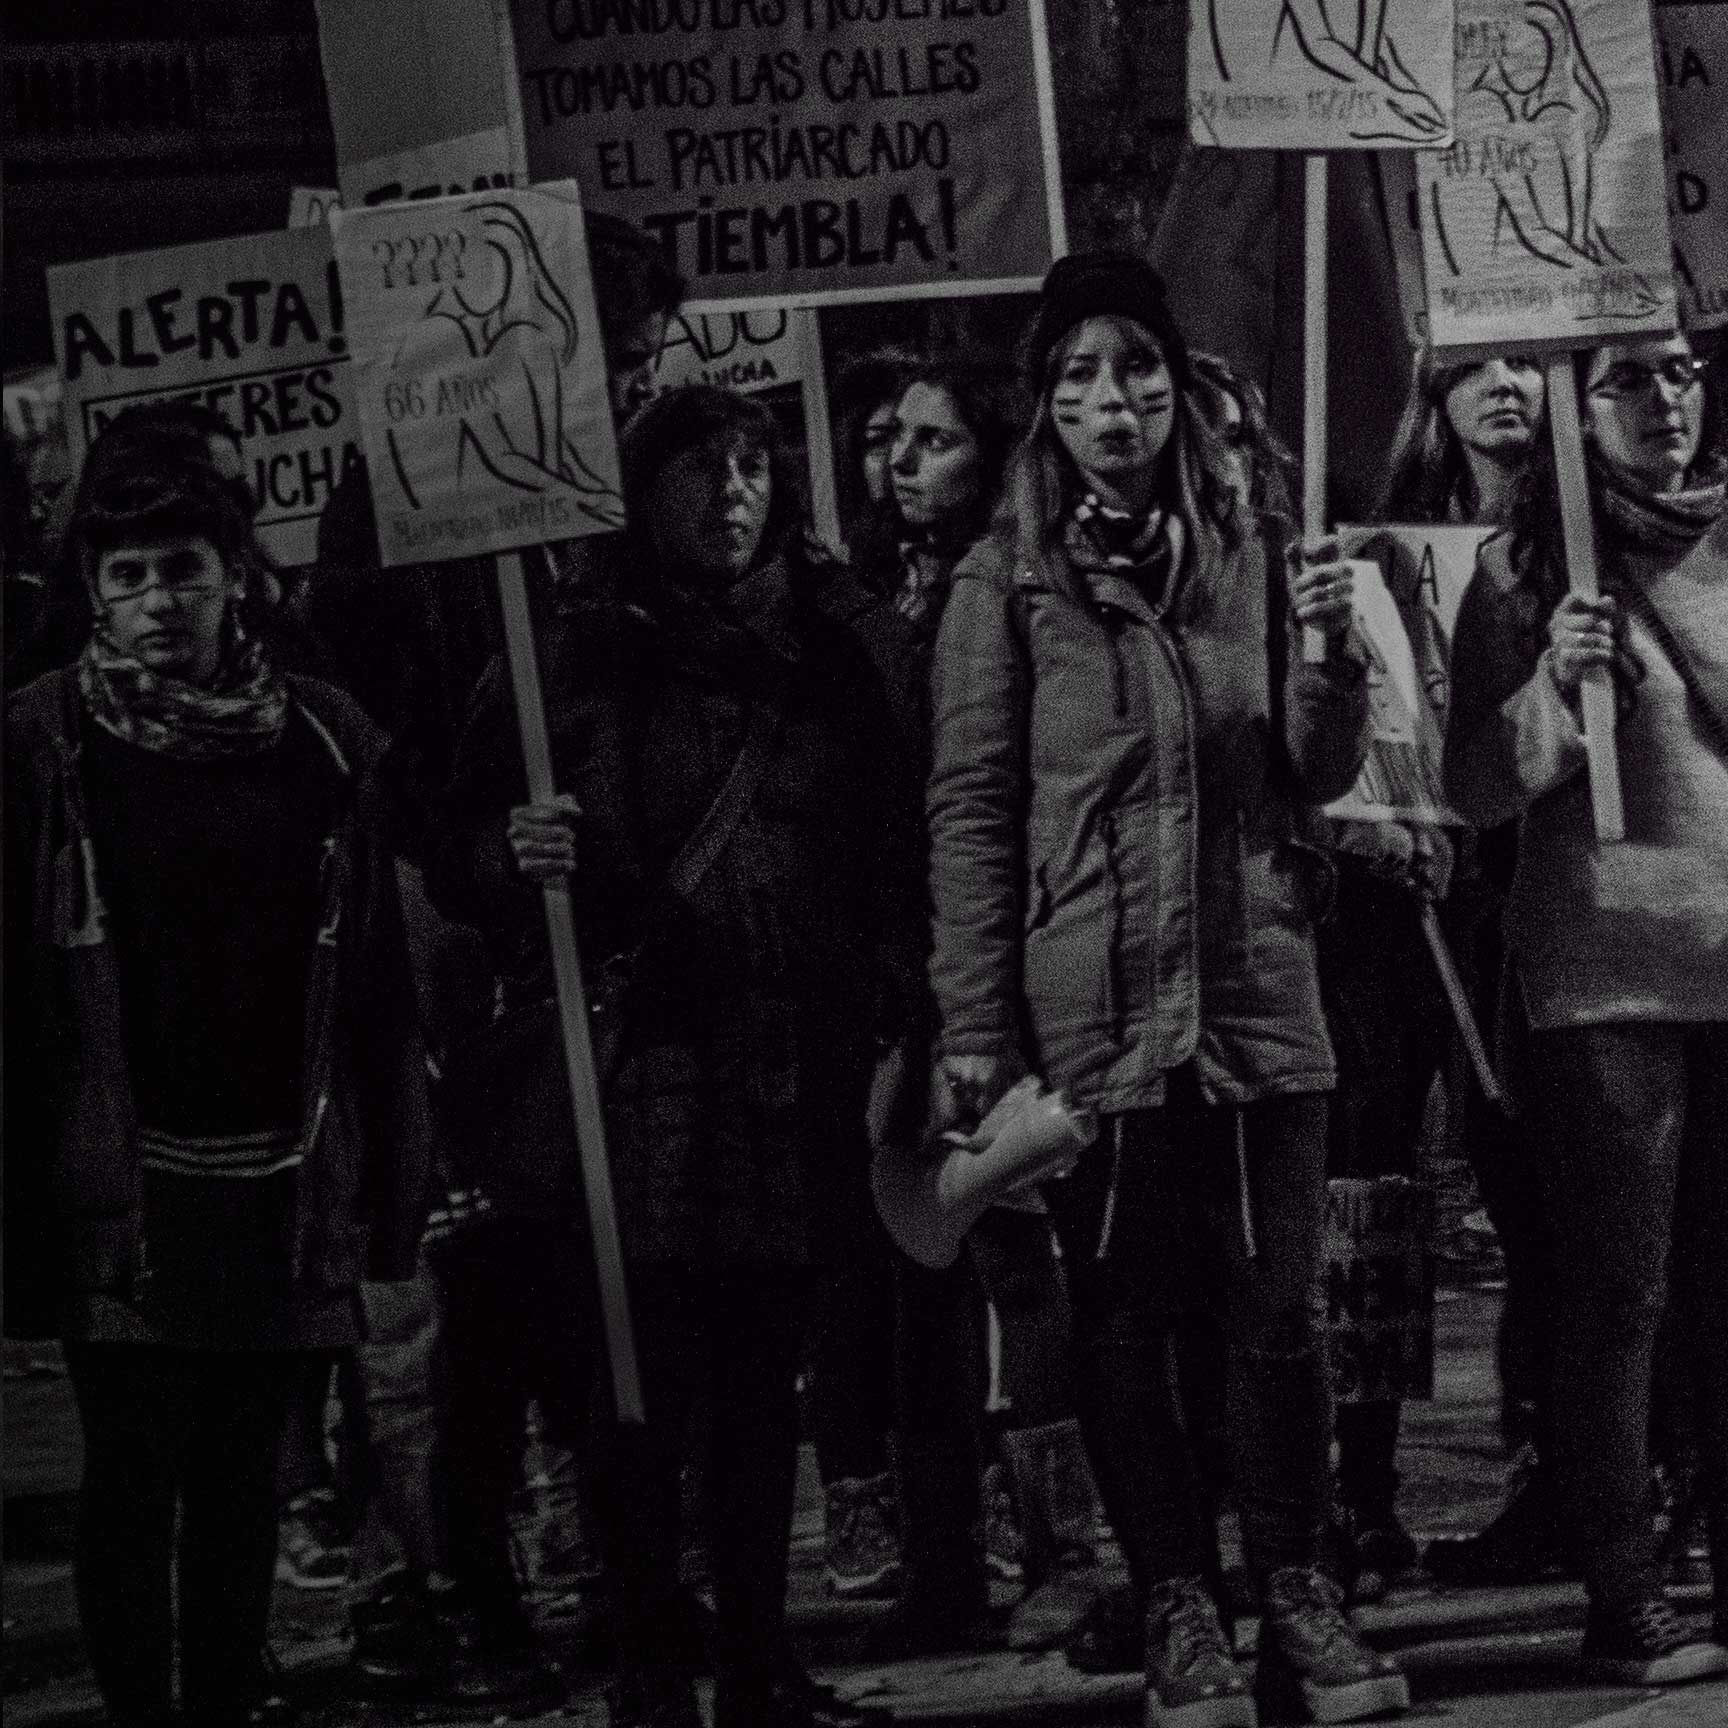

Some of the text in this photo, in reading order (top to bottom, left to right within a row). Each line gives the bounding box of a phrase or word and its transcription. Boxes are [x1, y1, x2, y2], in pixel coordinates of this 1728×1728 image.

[524, 42, 980, 126] TOMAMOS LAS CALLES
[599, 140, 652, 191] EL
[372, 228, 467, 290] ????
[65, 260, 346, 380] ALERTA!
[384, 373, 498, 423] 66 AÑOS
